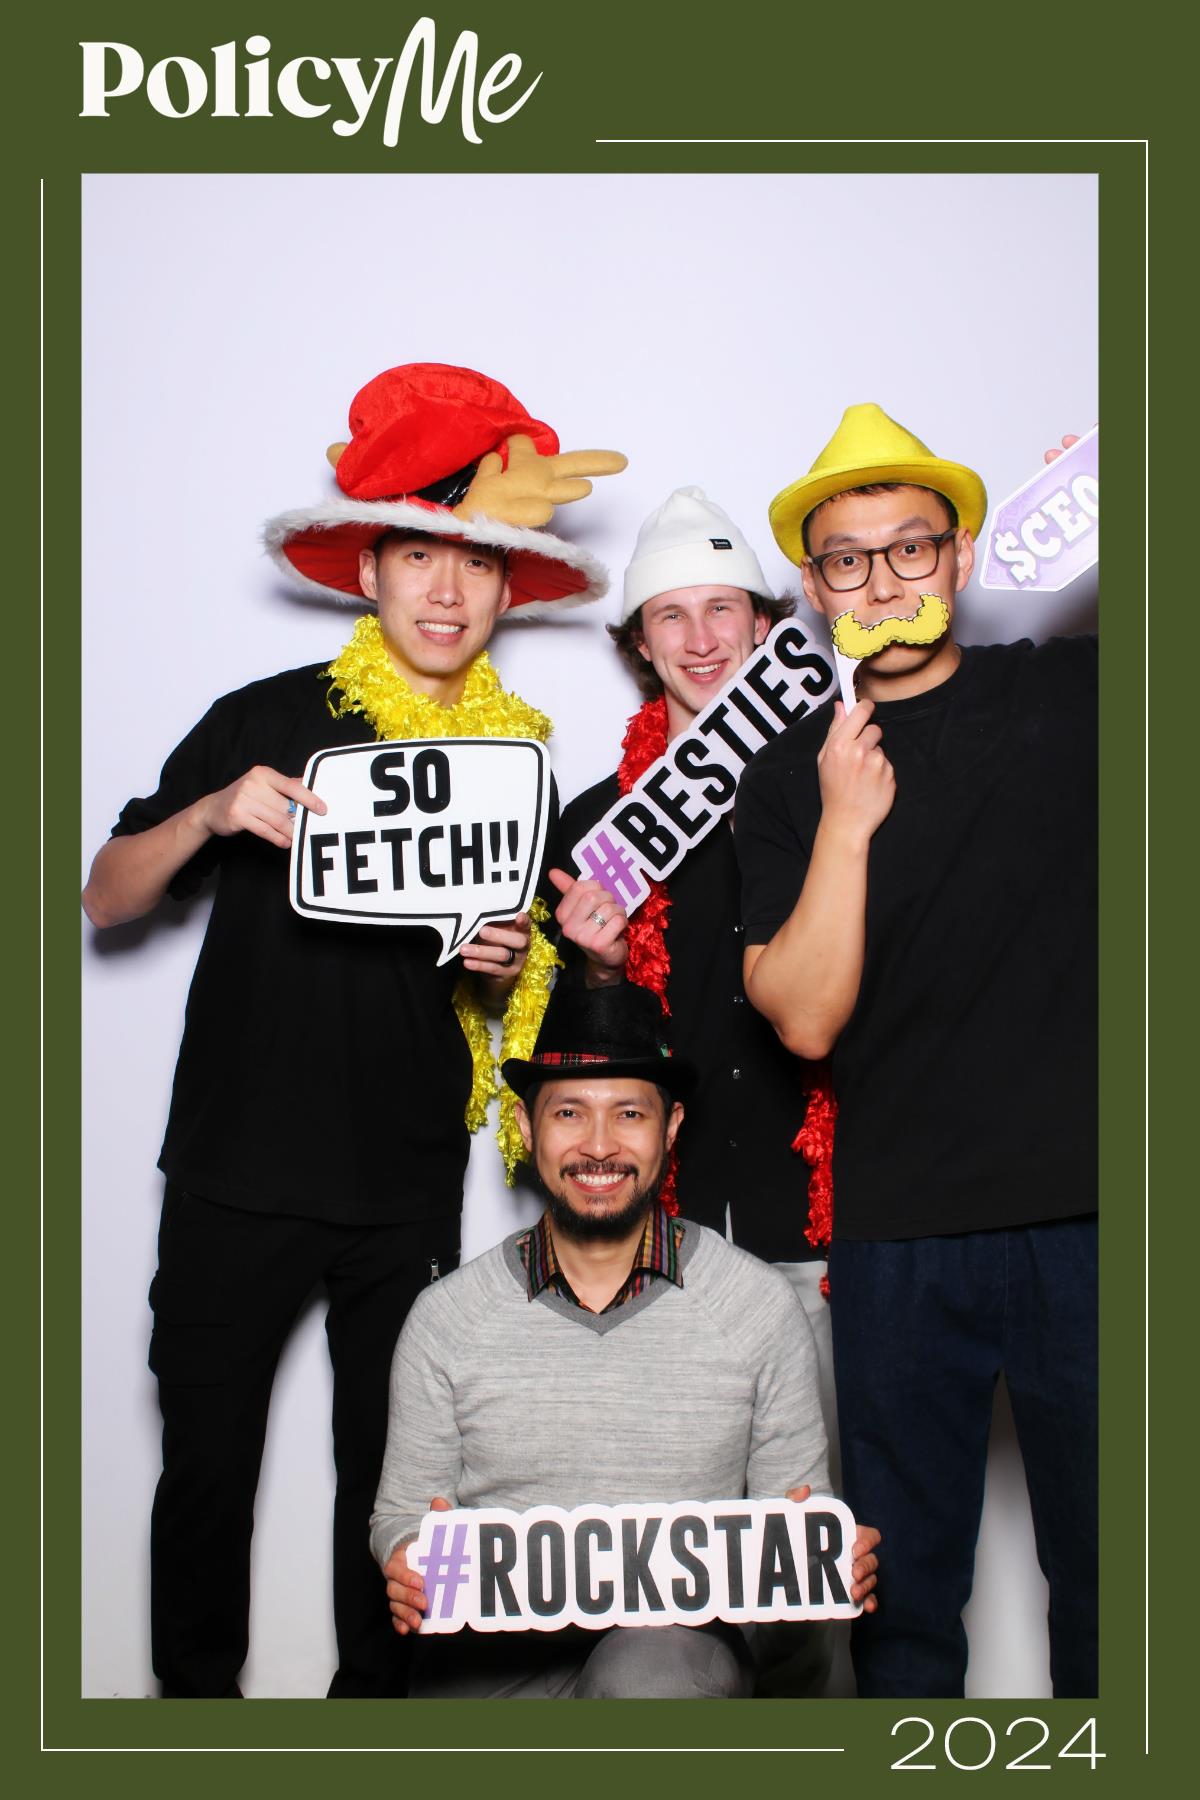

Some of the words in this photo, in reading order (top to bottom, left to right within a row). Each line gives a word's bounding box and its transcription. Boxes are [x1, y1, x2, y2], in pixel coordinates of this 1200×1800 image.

[370, 749, 450, 817] SO
[581, 627, 833, 909] #BESTIES
[310, 820, 519, 897] FETCH!!
[418, 1511, 851, 1619] #ROCKSTAR
